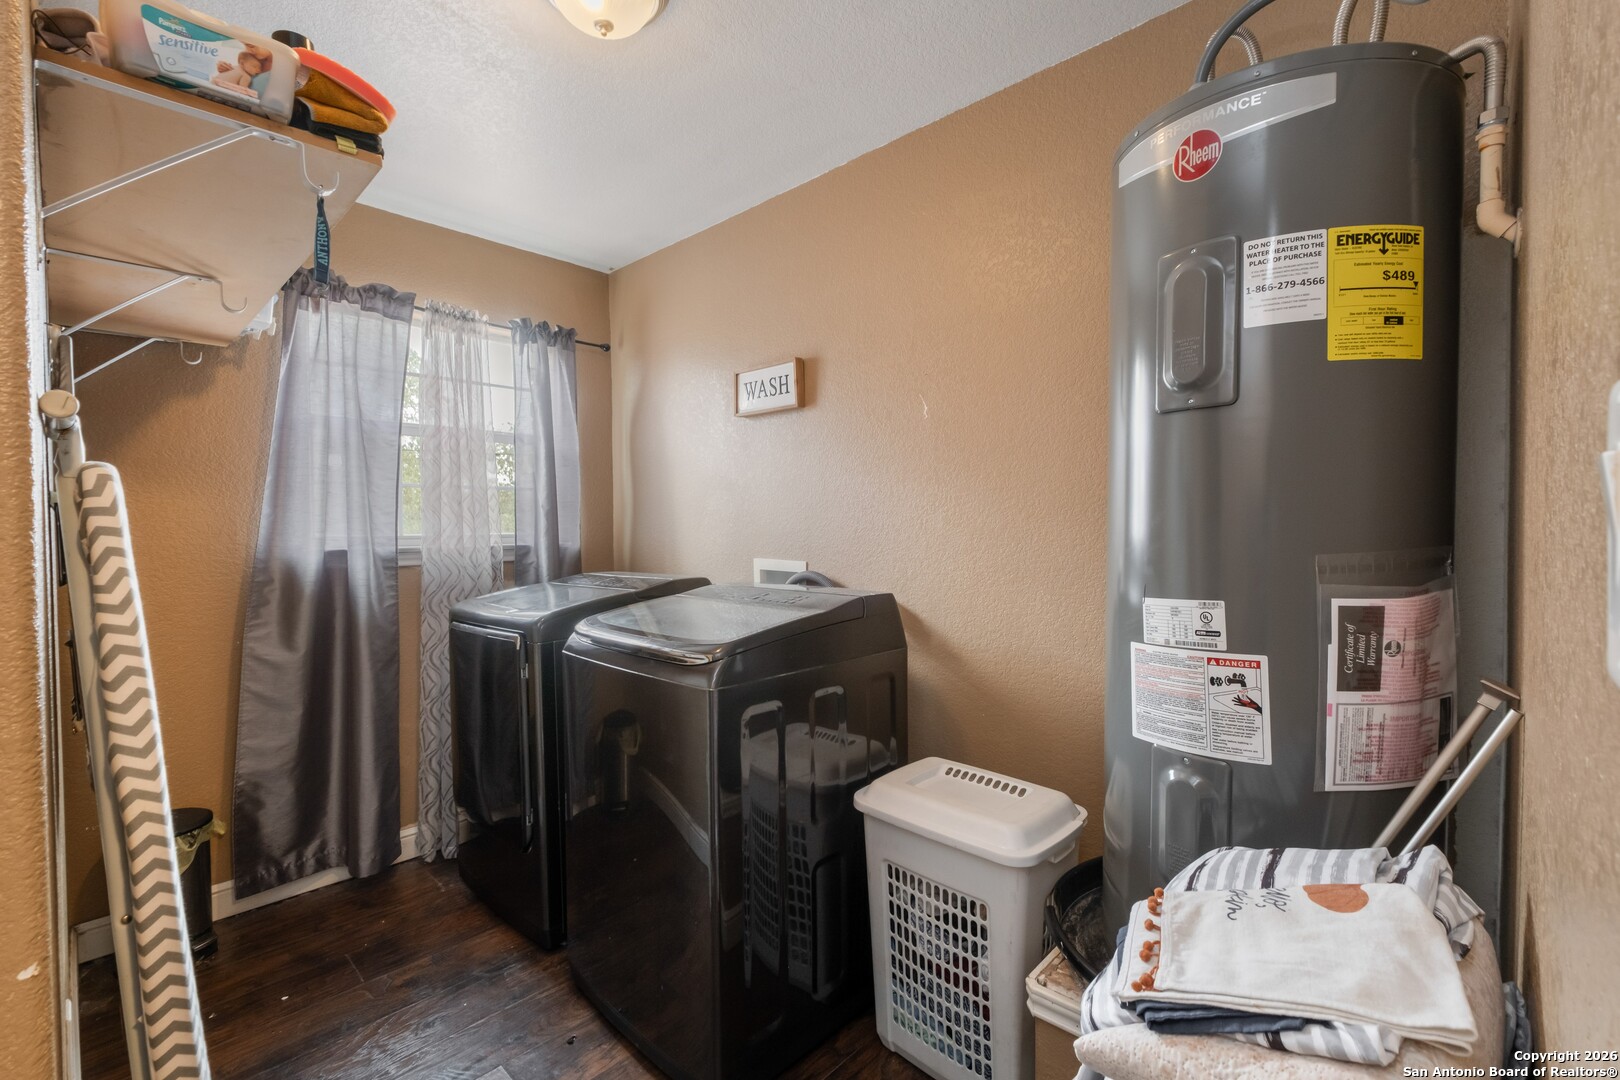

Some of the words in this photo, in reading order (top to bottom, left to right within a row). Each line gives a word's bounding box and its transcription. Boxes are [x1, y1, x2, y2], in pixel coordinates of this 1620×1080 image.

[158, 34, 219, 57] sensitive
[1178, 132, 1219, 177] Rheem
[317, 216, 328, 266] ANTHONY
[1248, 243, 1259, 251] DO
[1260, 239, 1276, 248] NO
[1276, 235, 1305, 245] RETURN
[1306, 233, 1323, 241] THIS
[1336, 232, 1420, 247] ENERGYGUIDE
[1246, 249, 1270, 259] WATER
[1273, 255, 1283, 263] OF
[1284, 250, 1322, 261] PURCHASE
[1382, 270, 1415, 281] $489
[1246, 276, 1325, 295] 1-866-279-4566
[744, 374, 790, 401] WASH
[1344, 622, 1357, 633] of
[1343, 633, 1356, 673] Certificate
[1356, 633, 1366, 664] Limited
[1366, 631, 1380, 666] Warranty
[1219, 659, 1257, 668] DANGER
